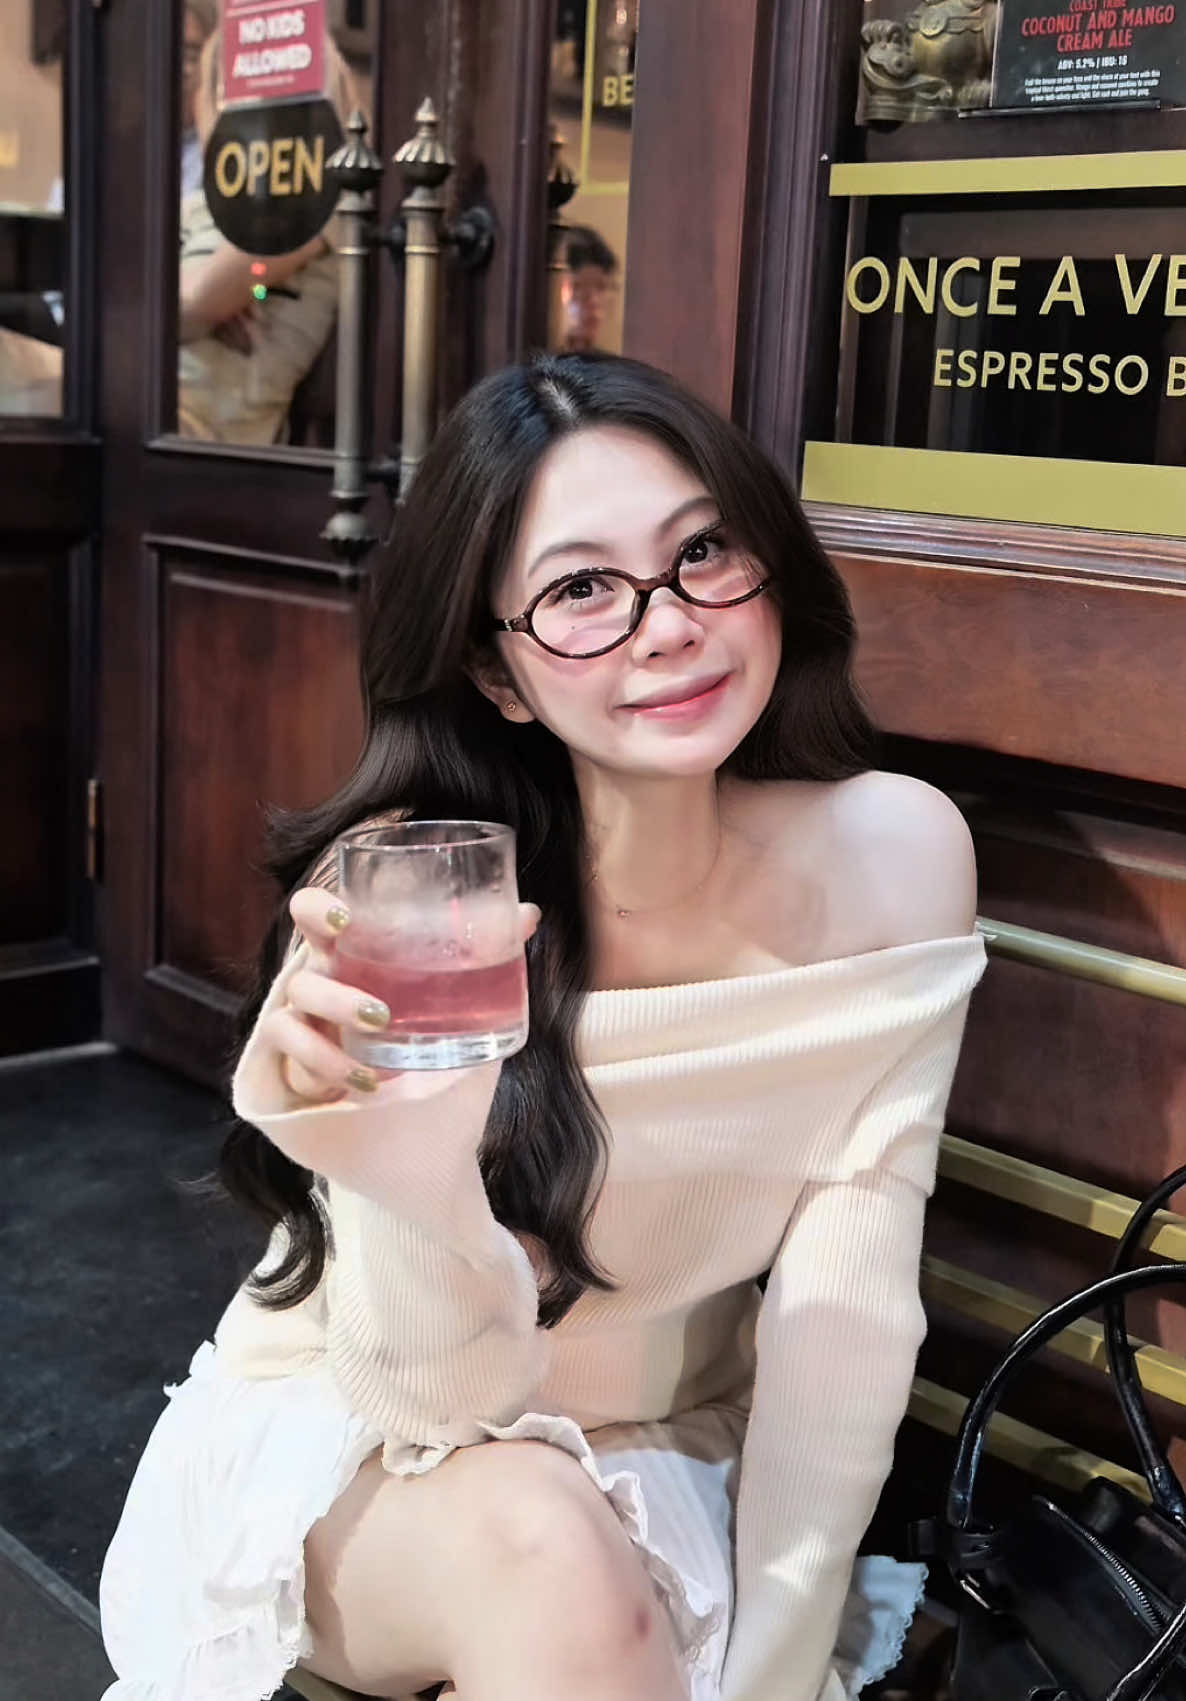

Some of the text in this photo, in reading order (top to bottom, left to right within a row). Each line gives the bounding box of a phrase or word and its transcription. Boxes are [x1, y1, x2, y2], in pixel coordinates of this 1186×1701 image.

[239, 9, 305, 44] NO KIDS
[1021, 4, 1175, 36] COCONUT AND MANGO
[1056, 28, 1133, 53] CREAM ALE
[232, 43, 313, 78] ALLOWED
[215, 135, 325, 198] OPEN
[846, 253, 1186, 317] ONCE A VE
[933, 348, 1149, 396] ESPRESSO
